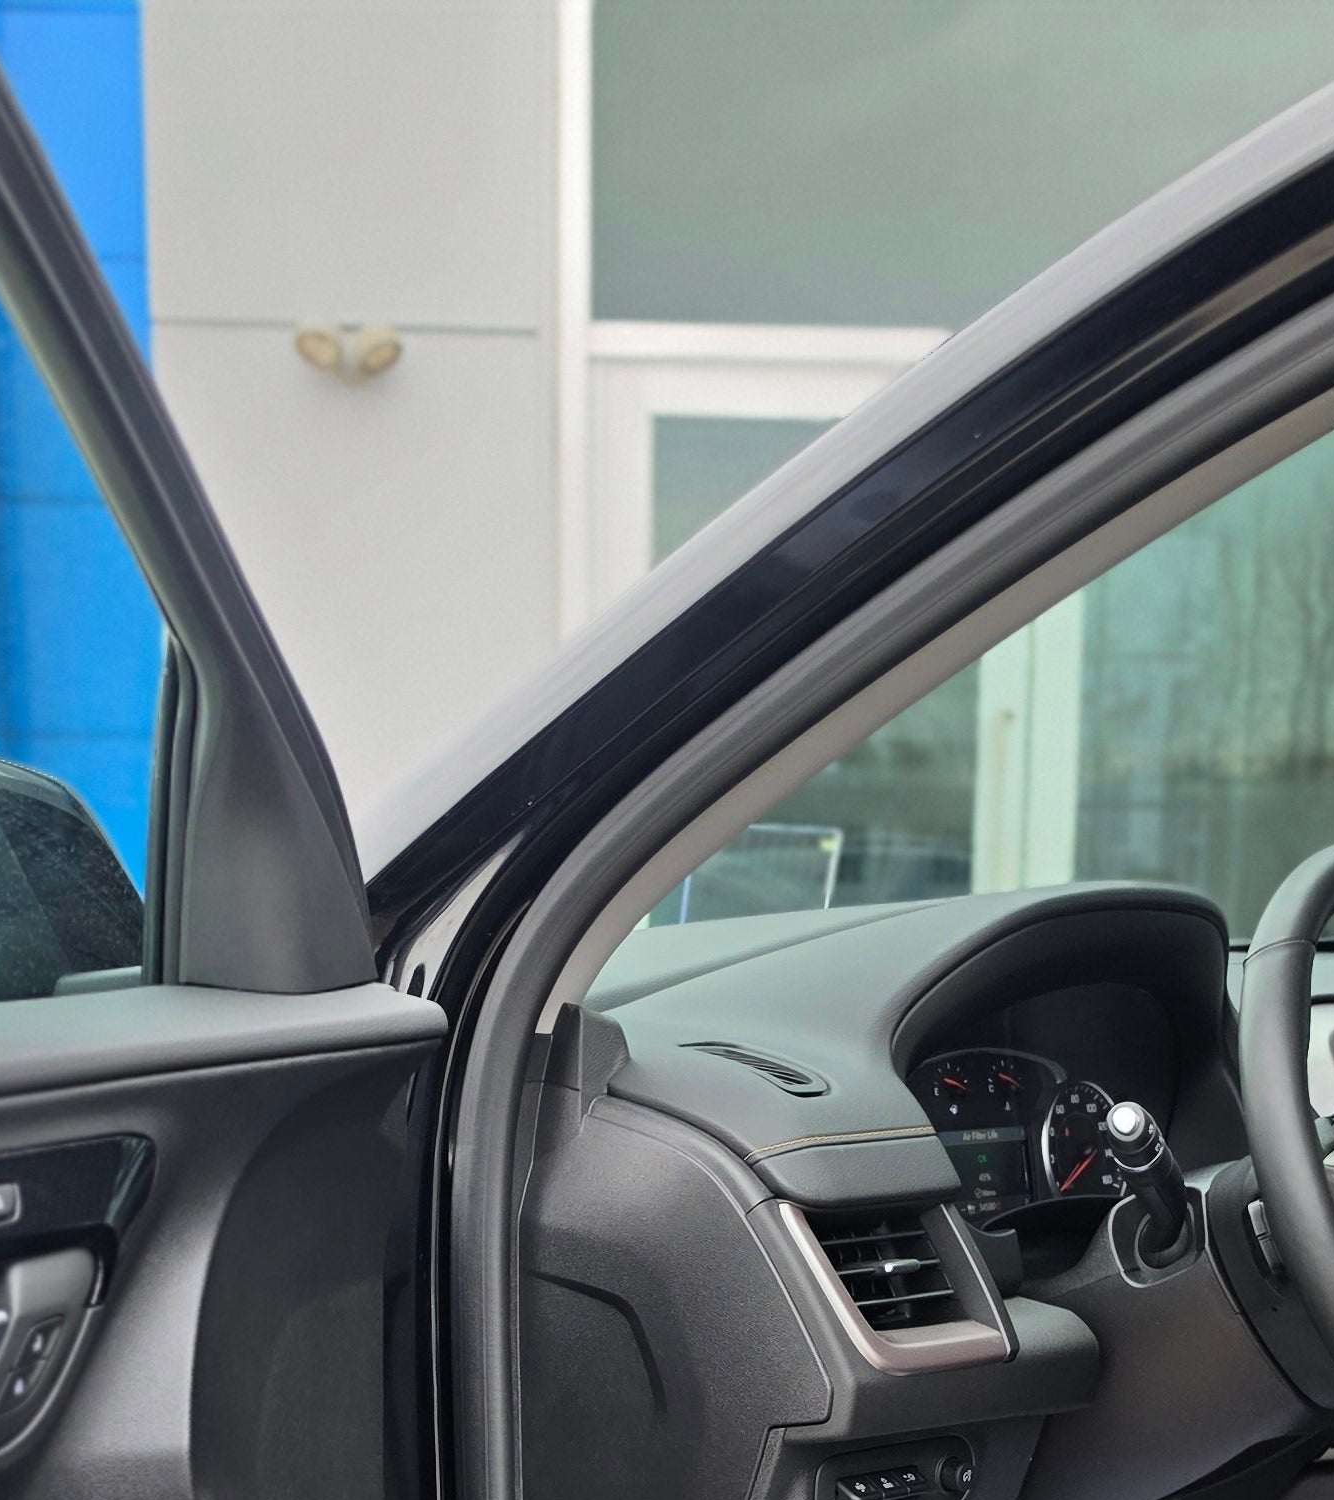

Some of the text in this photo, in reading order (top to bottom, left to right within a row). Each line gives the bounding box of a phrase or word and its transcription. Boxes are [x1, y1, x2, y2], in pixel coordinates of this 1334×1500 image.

[1070, 1093, 1080, 1104] 80
[1085, 1103, 1098, 1113] 100
[1101, 1174, 1113, 1185] 160
